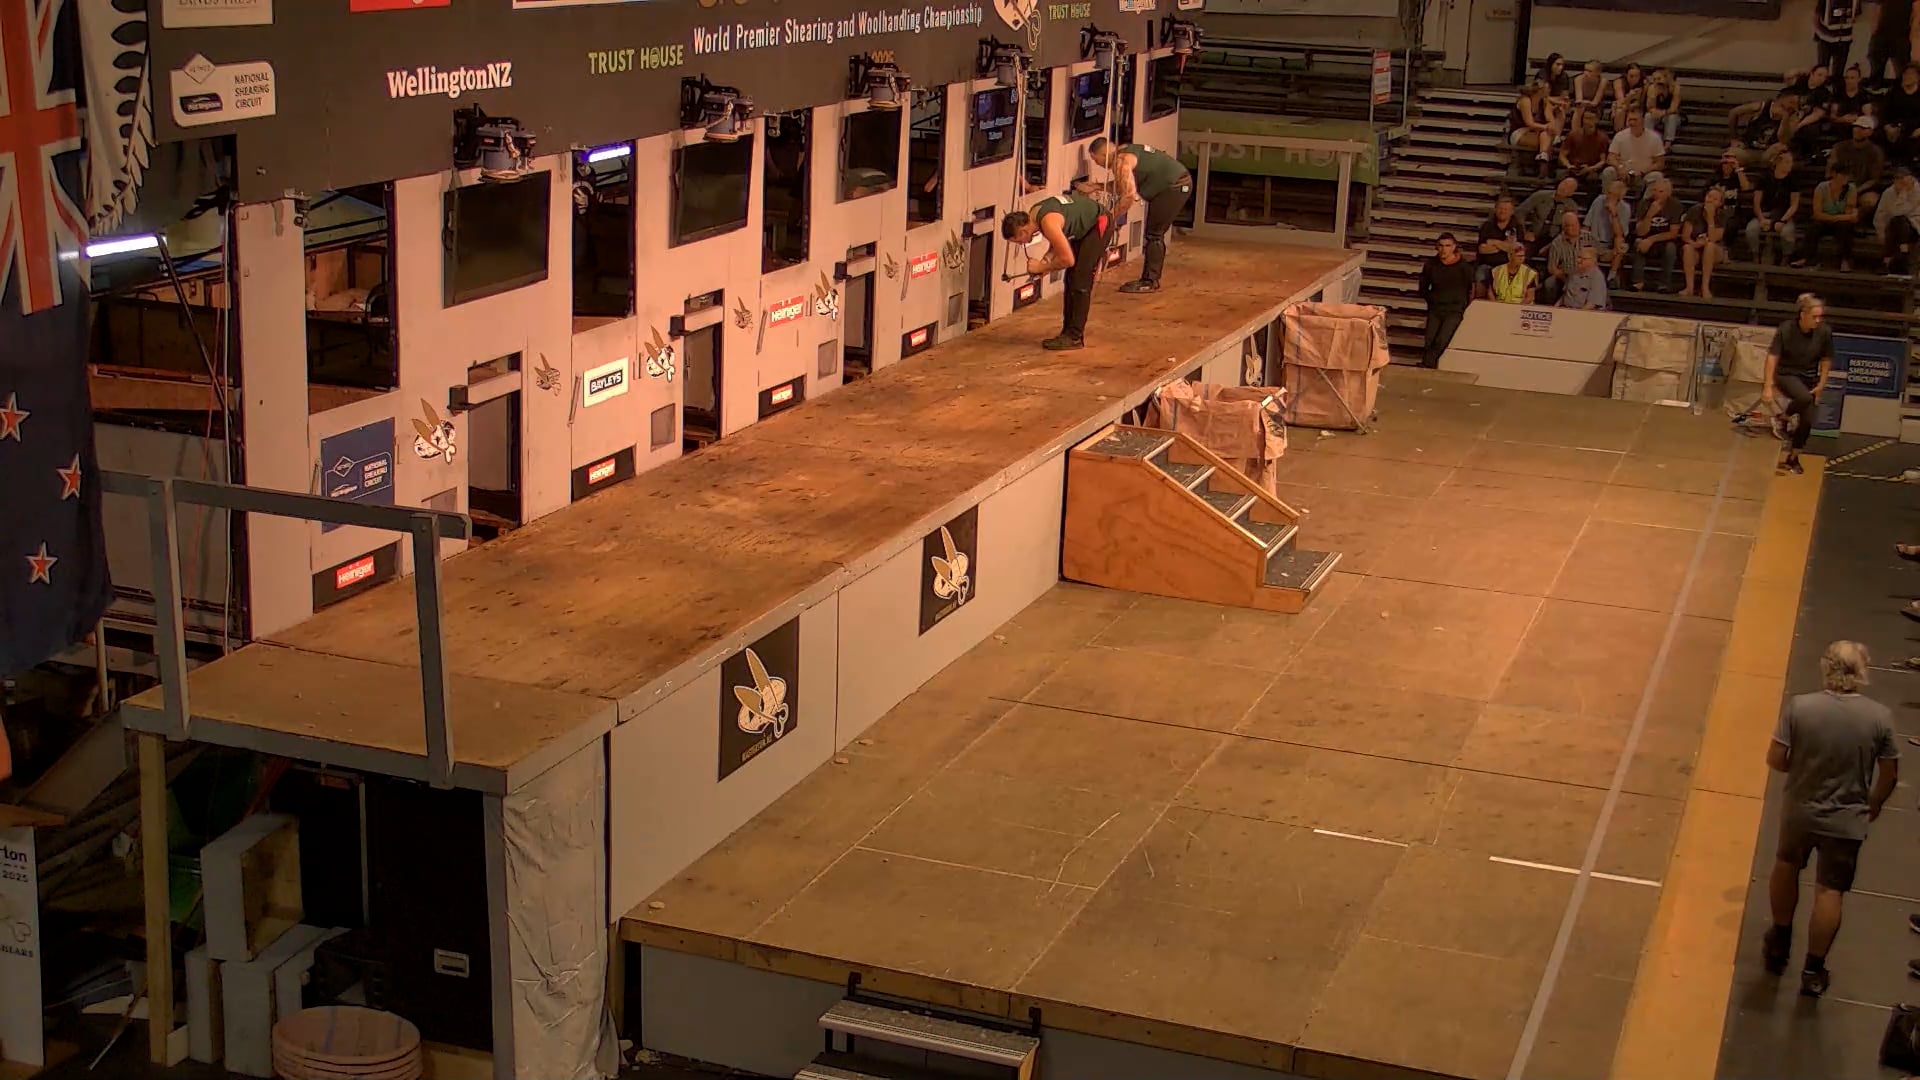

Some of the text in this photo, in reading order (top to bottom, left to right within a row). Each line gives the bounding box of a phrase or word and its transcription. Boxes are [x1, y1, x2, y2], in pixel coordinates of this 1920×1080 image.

[1049, 3, 1091, 21] TRUST HOUSE
[694, 3, 982, 55] World Premier Shearing and Woolhandling Championship
[588, 44, 684, 75] TRUST HOUSE
[234, 72, 270, 84] NATIONAL
[386, 62, 512, 99] WellingtonNZ
[235, 84, 270, 97] SHEARING
[235, 97, 262, 109] CIRCUIT
[1520, 311, 1552, 321] NOTICE
[1848, 359, 1889, 370] NATIONAL
[1848, 367, 1890, 378] SHEARING
[590, 371, 622, 393] BAYLEYS
[1847, 375, 1880, 385] CIRCUIT
